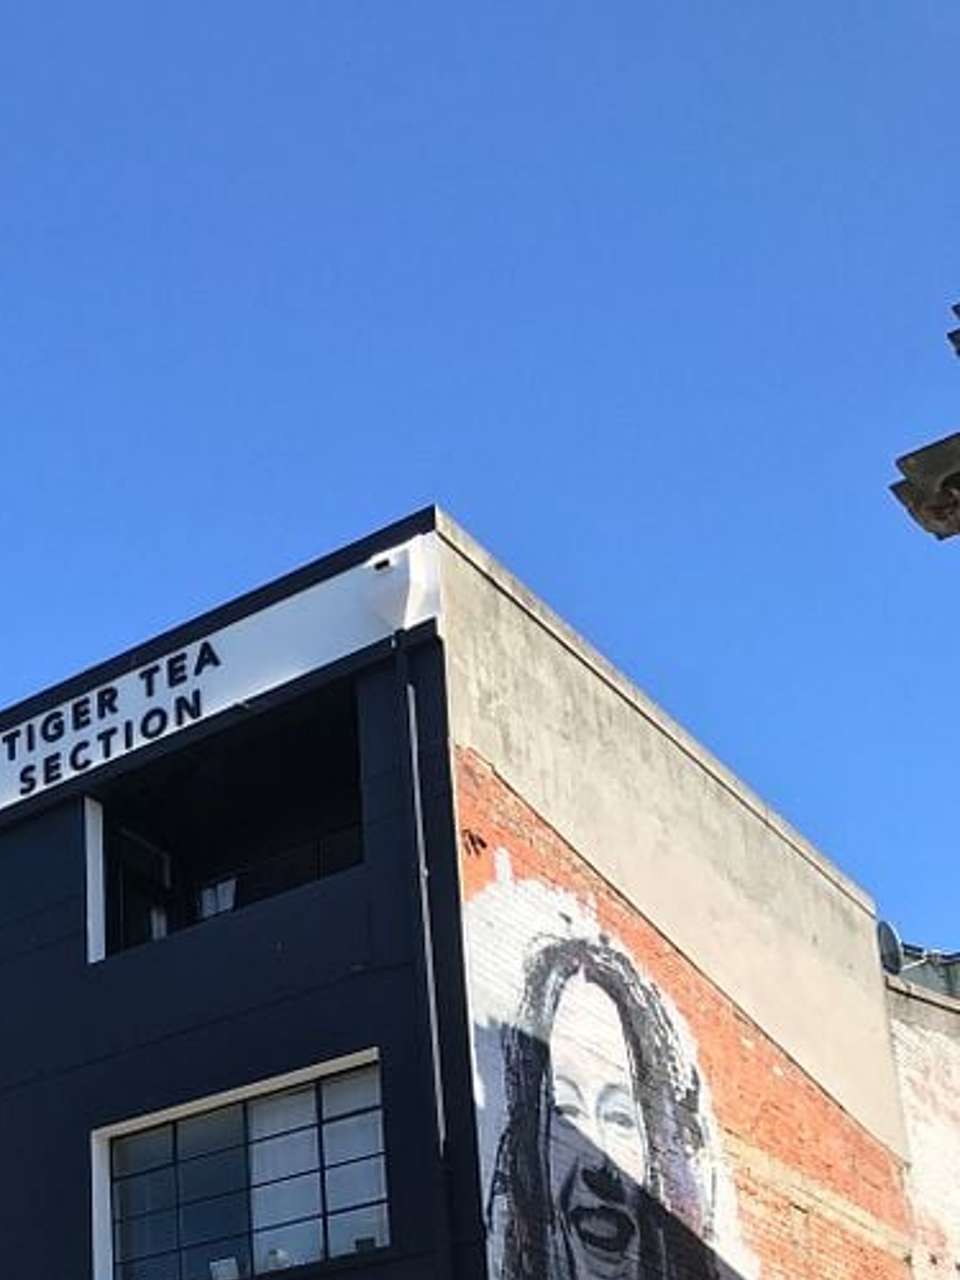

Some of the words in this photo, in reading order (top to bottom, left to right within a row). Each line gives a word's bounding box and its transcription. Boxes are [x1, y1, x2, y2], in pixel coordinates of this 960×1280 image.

[1, 685, 119, 762] TIGER
[138, 640, 222, 698] TEA
[19, 688, 202, 797] SECTION
